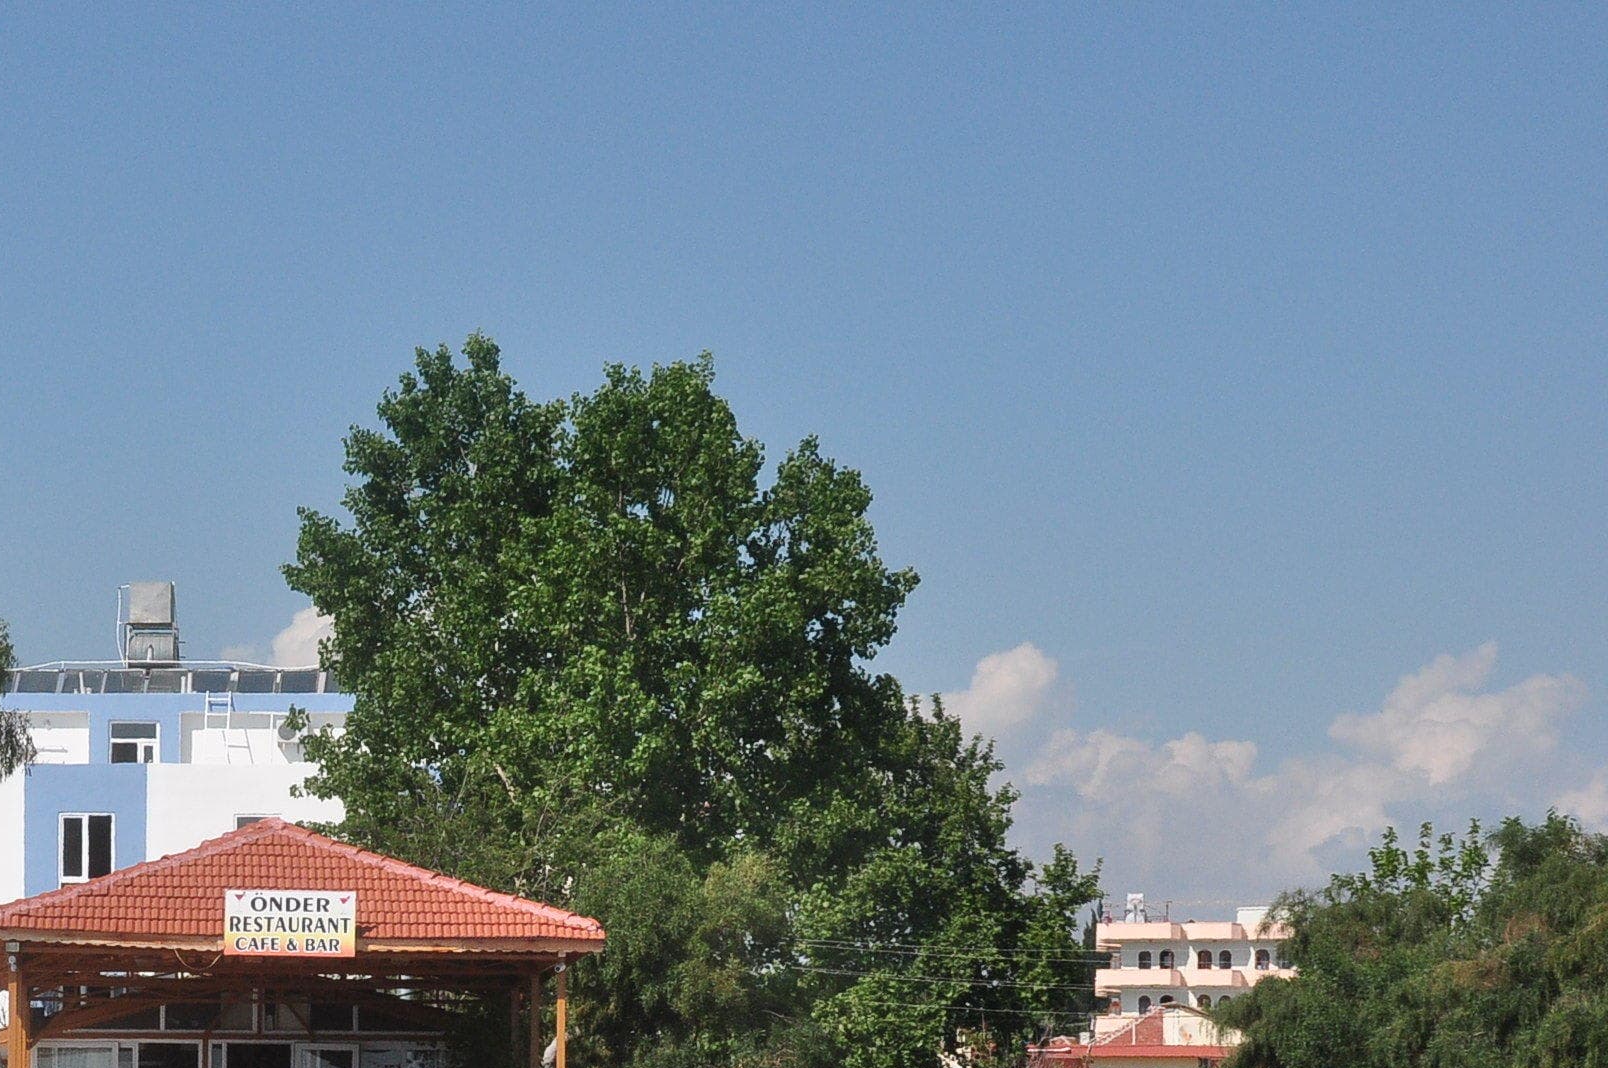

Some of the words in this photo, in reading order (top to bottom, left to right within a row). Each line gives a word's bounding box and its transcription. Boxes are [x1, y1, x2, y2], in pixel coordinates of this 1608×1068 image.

[251, 892, 330, 912] ÖNDER
[229, 915, 351, 933] RESTAURANT
[235, 937, 279, 951] CAFE
[286, 938, 297, 951] &
[305, 938, 340, 952] BAR
